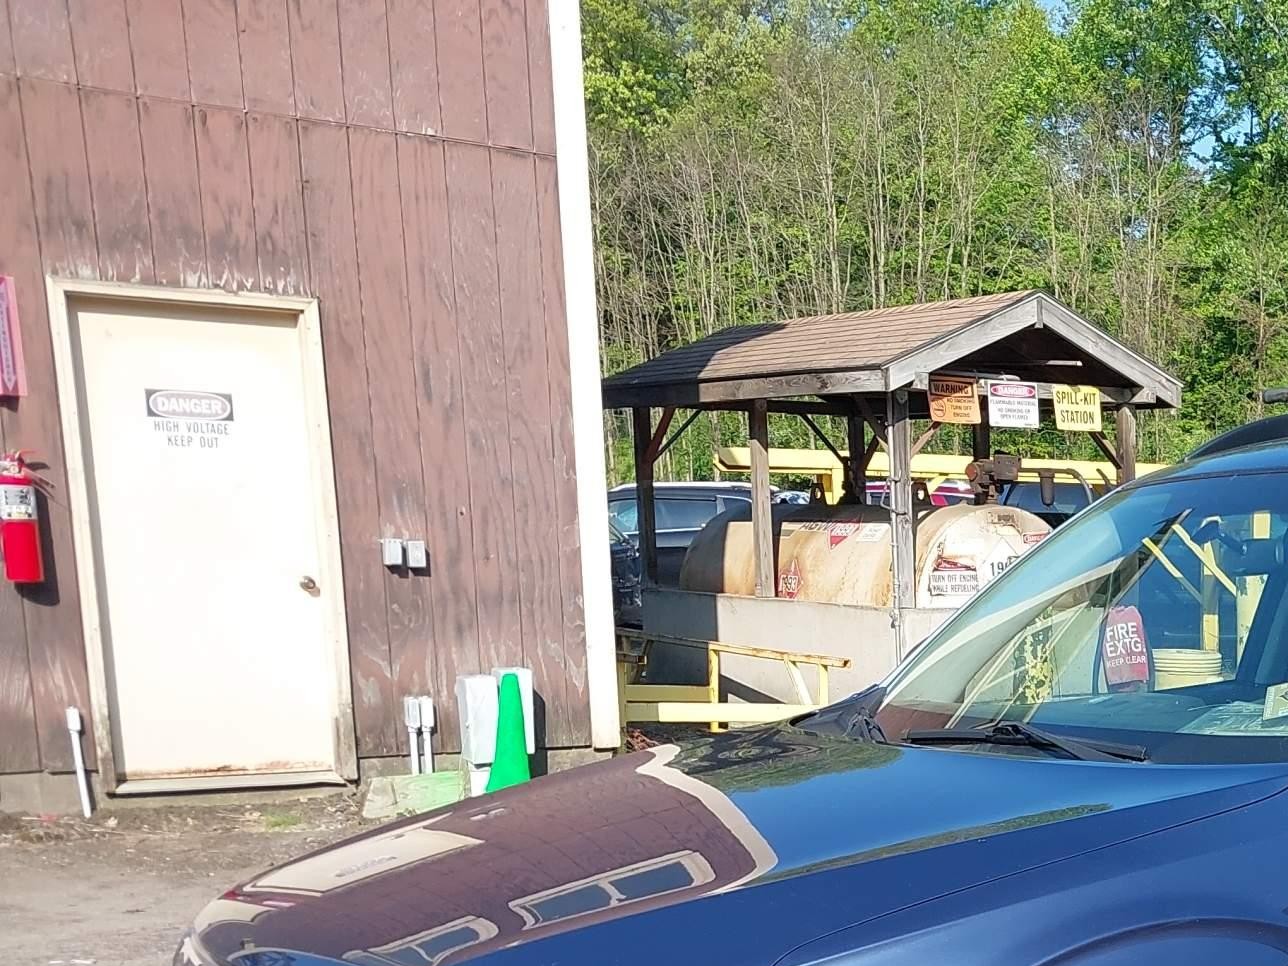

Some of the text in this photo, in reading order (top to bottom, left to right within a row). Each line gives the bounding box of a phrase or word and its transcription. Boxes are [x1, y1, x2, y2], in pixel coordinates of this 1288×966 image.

[933, 383, 969, 394] WARNING
[156, 396, 223, 414] DANGER
[1056, 390, 1096, 406] SPILL-KIT
[1060, 409, 1095, 425] STATION
[153, 420, 230, 436] HIGH VOLTAGE
[167, 435, 219, 449] KEEP OUT
[947, 574, 957, 582] OFF
[1106, 622, 1138, 641] FIRE
[1105, 637, 1147, 657] EXTG.
[1106, 655, 1147, 669] KEEP CLEAR
